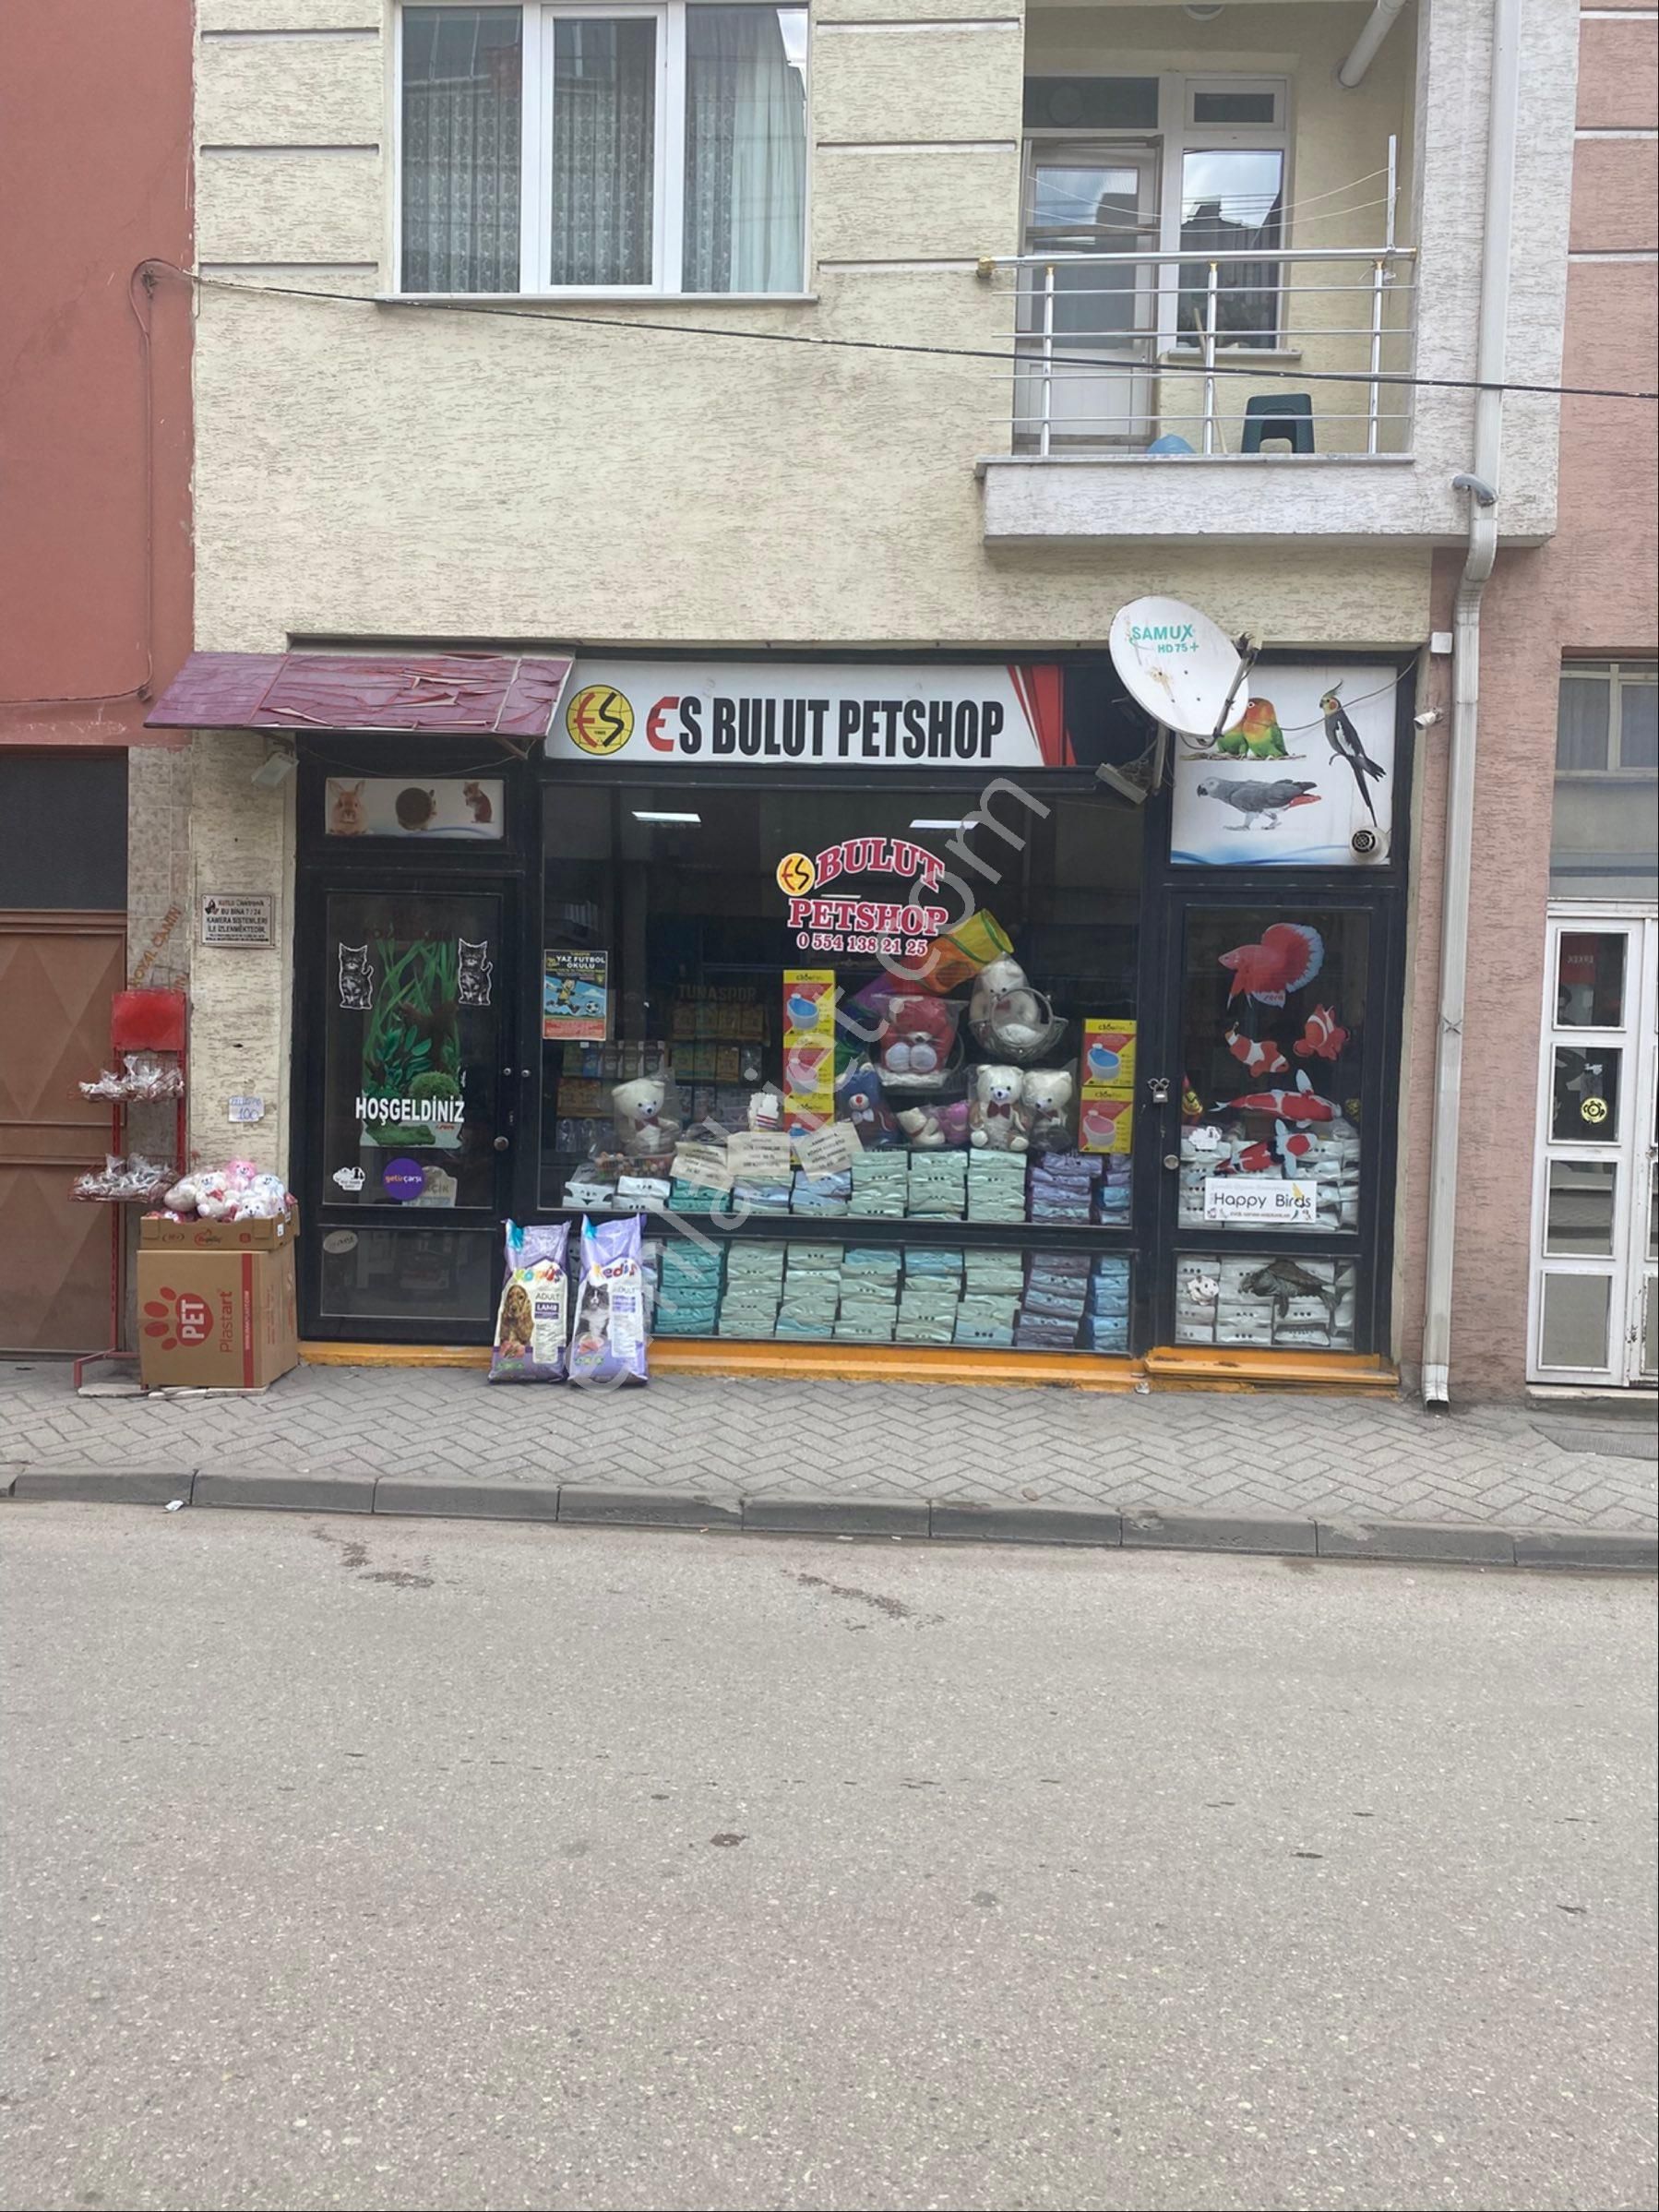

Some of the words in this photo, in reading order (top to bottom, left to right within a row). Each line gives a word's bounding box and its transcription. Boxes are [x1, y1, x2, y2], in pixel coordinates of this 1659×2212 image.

[1131, 624, 1193, 641] SAMUX
[647, 696, 702, 754] ES
[712, 698, 830, 757] BULUT
[838, 699, 1004, 759] PETSHOP
[814, 837, 946, 893] BULUT
[787, 898, 949, 937] PETSHOP
[797, 931, 809, 949] 0
[813, 932, 843, 951] 554
[848, 935, 877, 954] 138
[882, 937, 901, 955] 21
[905, 939, 928, 956] 25
[355, 1095, 465, 1126] HOŞGELDİNİZ
[1214, 1192, 1268, 1209] Happy
[1275, 1193, 1311, 1208] Birds
[182, 1299, 205, 1338] PET
[220, 1291, 233, 1353] Plastart
